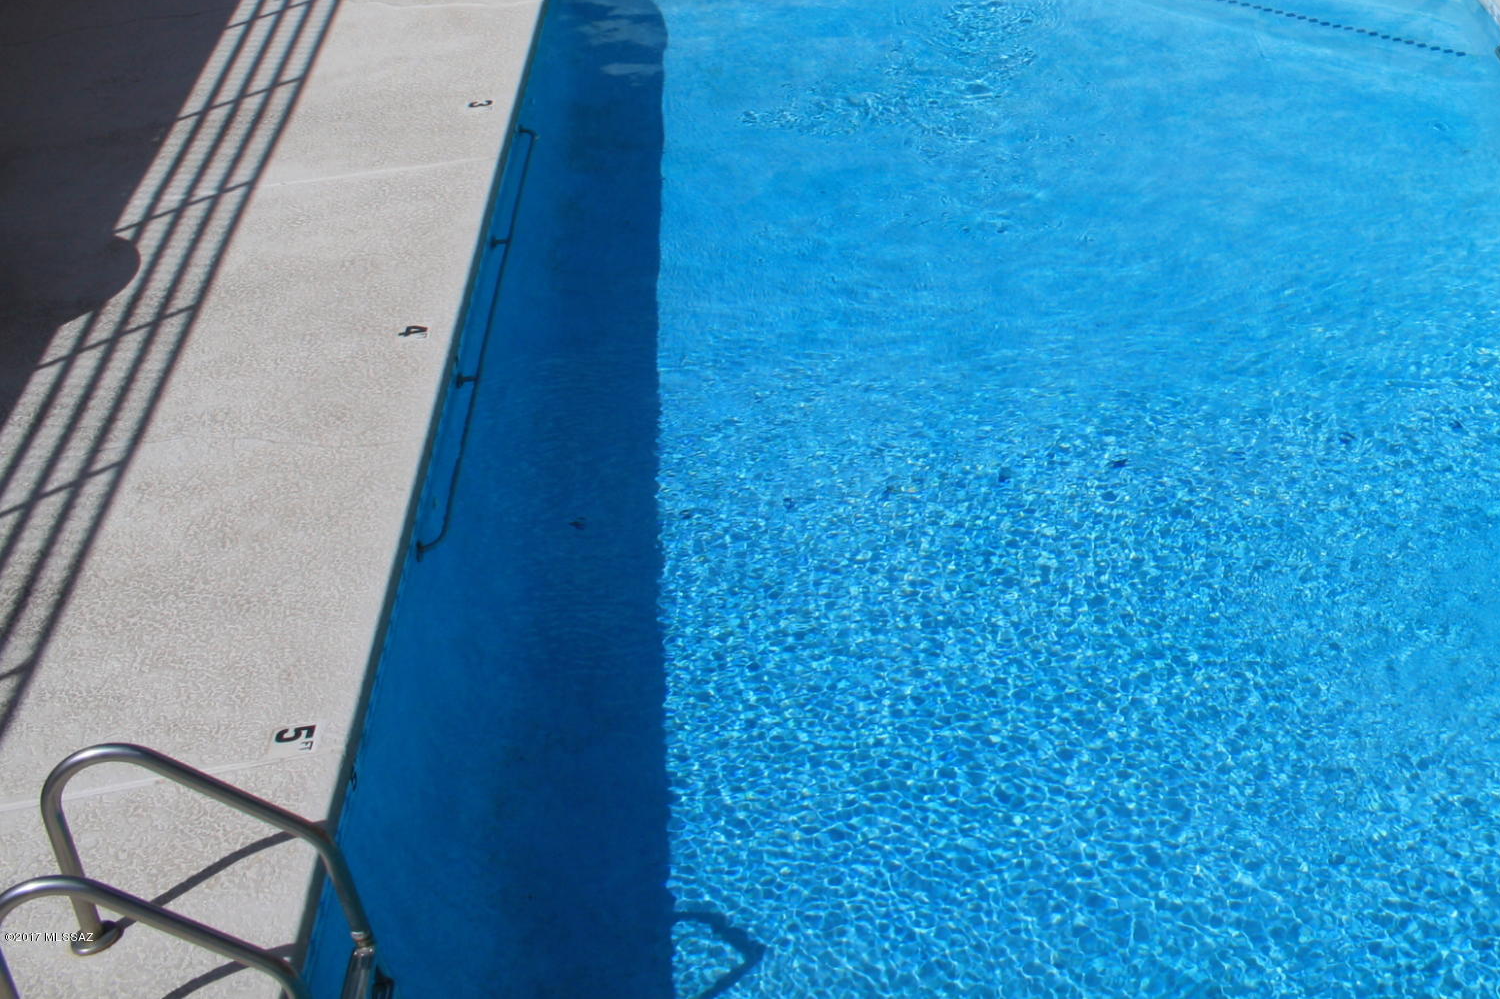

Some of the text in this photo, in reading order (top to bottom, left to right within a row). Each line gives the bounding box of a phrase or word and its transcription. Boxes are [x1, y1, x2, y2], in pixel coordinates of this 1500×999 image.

[468, 99, 493, 108] 3
[398, 325, 428, 337] 4
[275, 724, 316, 743] 5
